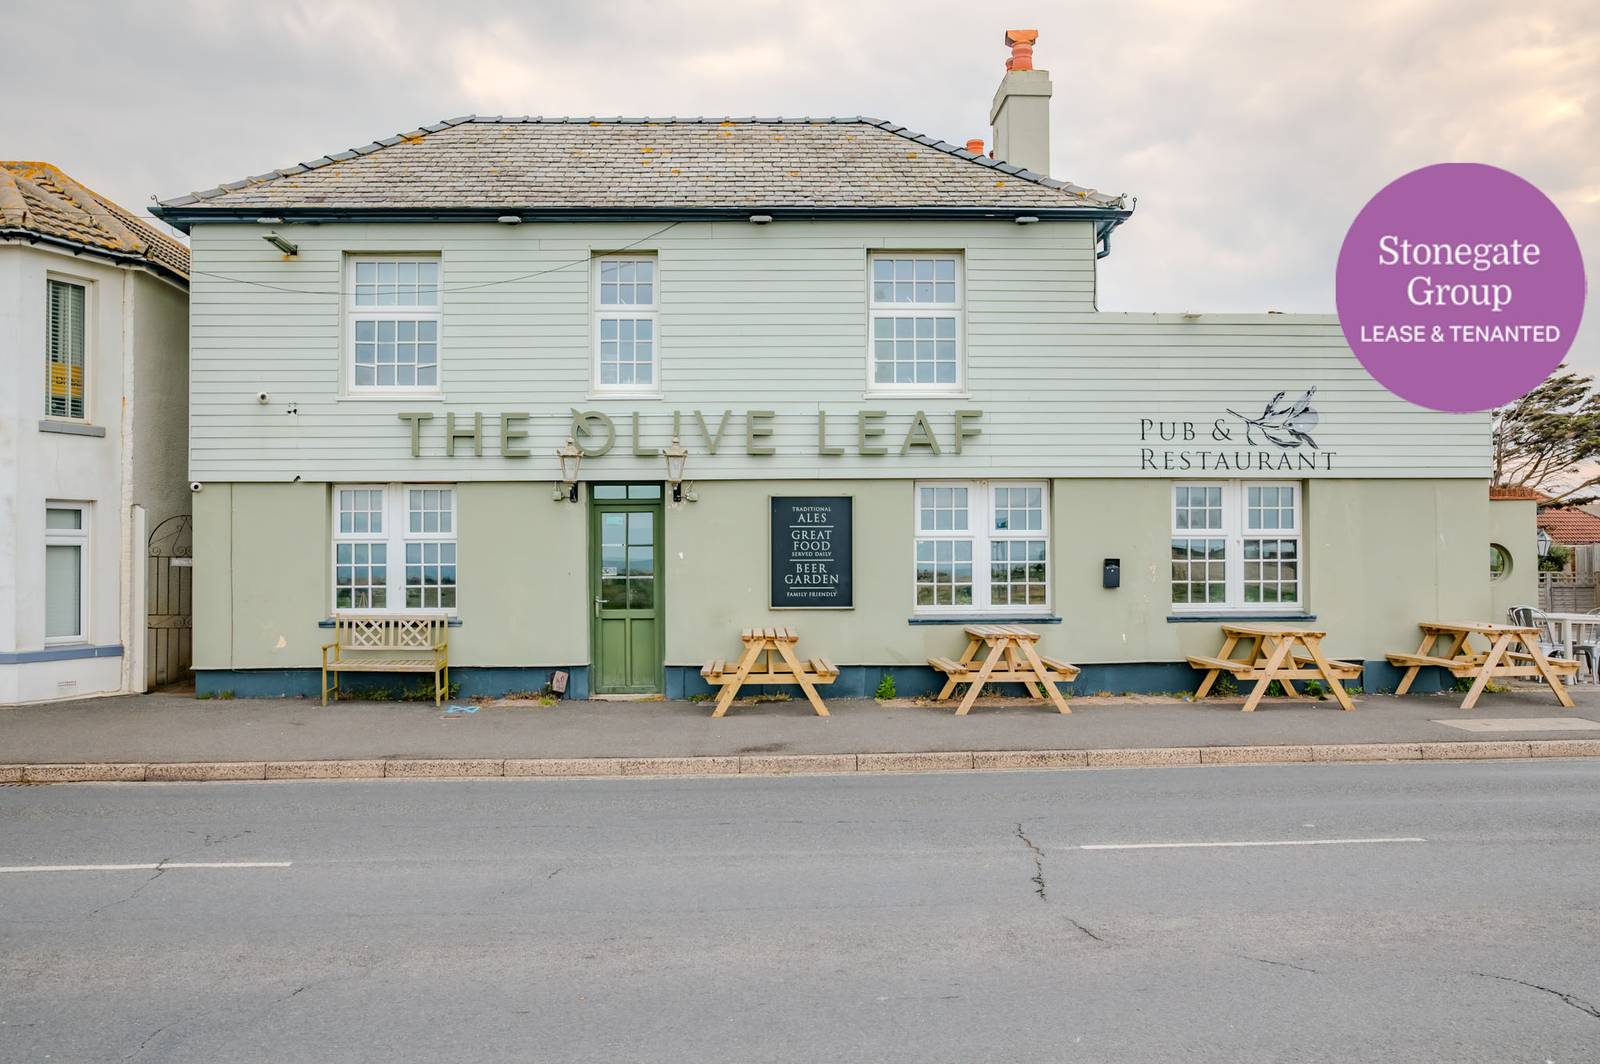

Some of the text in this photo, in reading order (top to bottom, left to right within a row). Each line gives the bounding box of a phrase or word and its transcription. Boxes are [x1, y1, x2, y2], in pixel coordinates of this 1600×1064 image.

[398, 408, 983, 458] THE OLIVE LEAF
[1212, 418, 1233, 442] &
[797, 513, 827, 523] ALES
[791, 530, 832, 540] GREAT
[793, 541, 831, 551] FOOD
[796, 563, 827, 573] BEER
[784, 574, 839, 584] GARDEN
